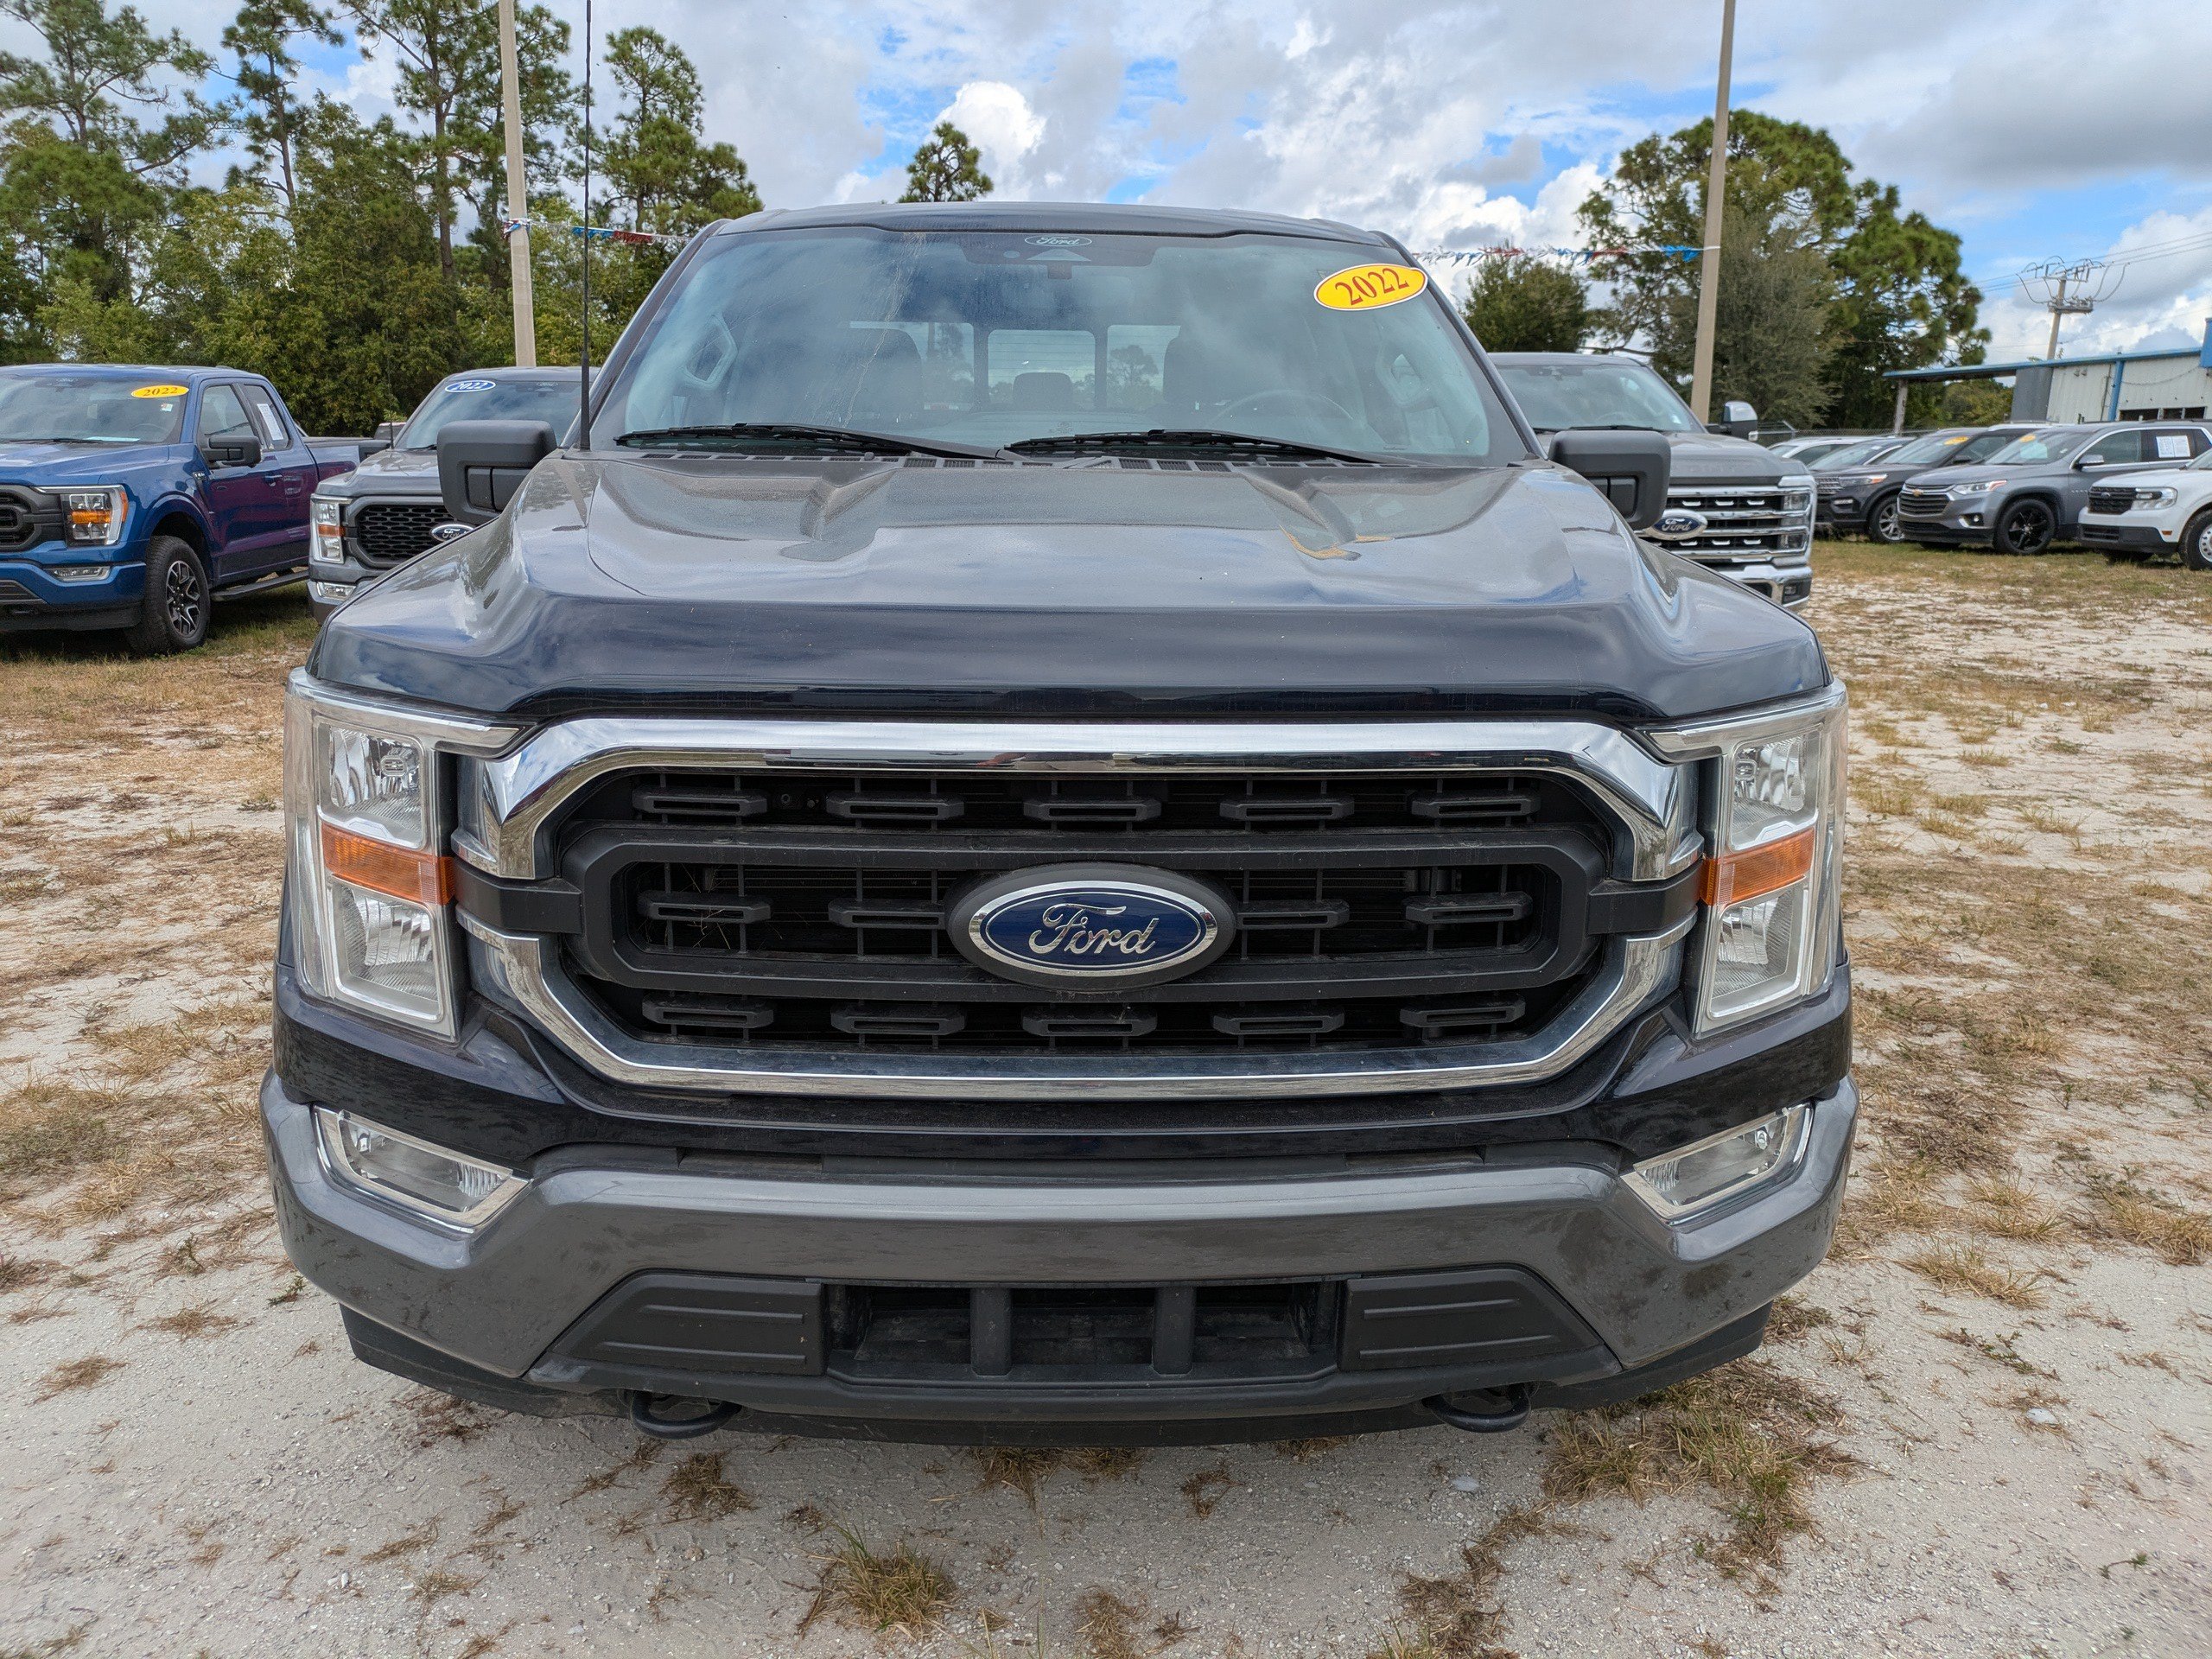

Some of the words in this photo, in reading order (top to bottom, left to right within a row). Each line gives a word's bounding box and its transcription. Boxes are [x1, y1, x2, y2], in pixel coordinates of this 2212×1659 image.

[1035, 236, 1080, 246] Ford
[1334, 267, 1410, 306] 2022
[143, 386, 178, 397] 2022
[1661, 518, 1693, 531] Ford
[1028, 903, 1160, 954] Ford
